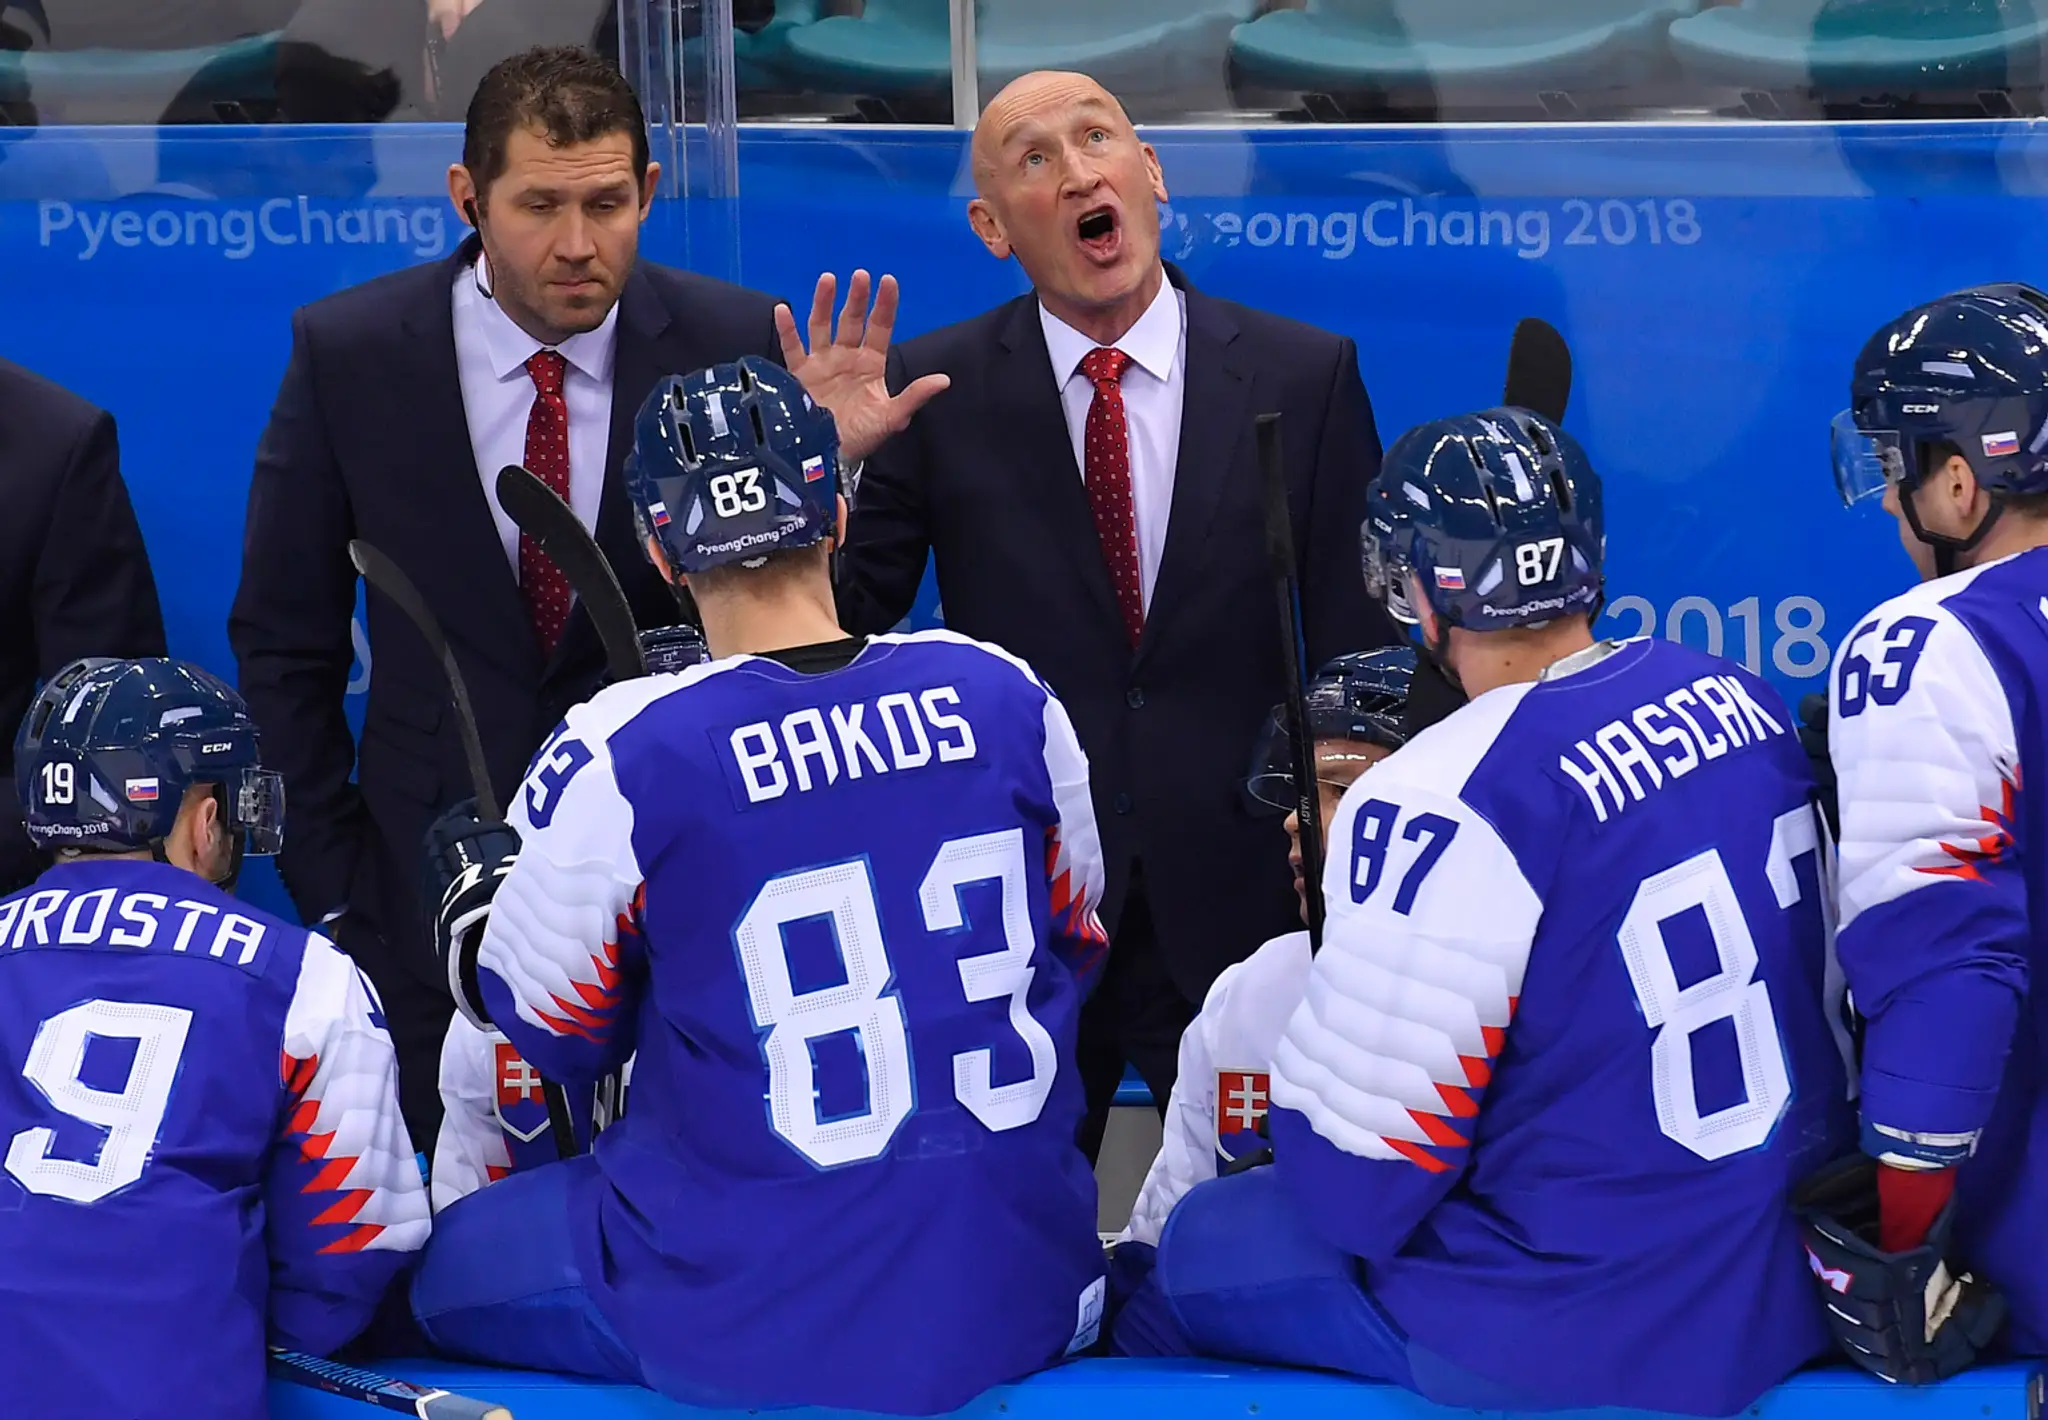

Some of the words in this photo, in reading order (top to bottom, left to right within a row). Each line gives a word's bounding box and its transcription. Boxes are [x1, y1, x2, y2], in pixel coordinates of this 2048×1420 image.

[40, 196, 444, 259] PyeongChang
[1563, 199, 1702, 246] 2018
[710, 466, 767, 518] 83
[697, 529, 779, 556] PyeongChang
[780, 517, 807, 536] 2018
[1515, 537, 1565, 586] 87
[1605, 595, 1831, 679] 2018
[1838, 614, 1939, 719] 63
[202, 742, 233, 754] CCM
[729, 686, 977, 804] BAKOS
[1559, 675, 1785, 823] HASCAK
[41, 761, 75, 805] 19
[83, 822, 109, 836] 2018
[1300, 794, 1312, 826] NAGY
[1349, 797, 1461, 917] 87
[734, 826, 1058, 1168] 83
